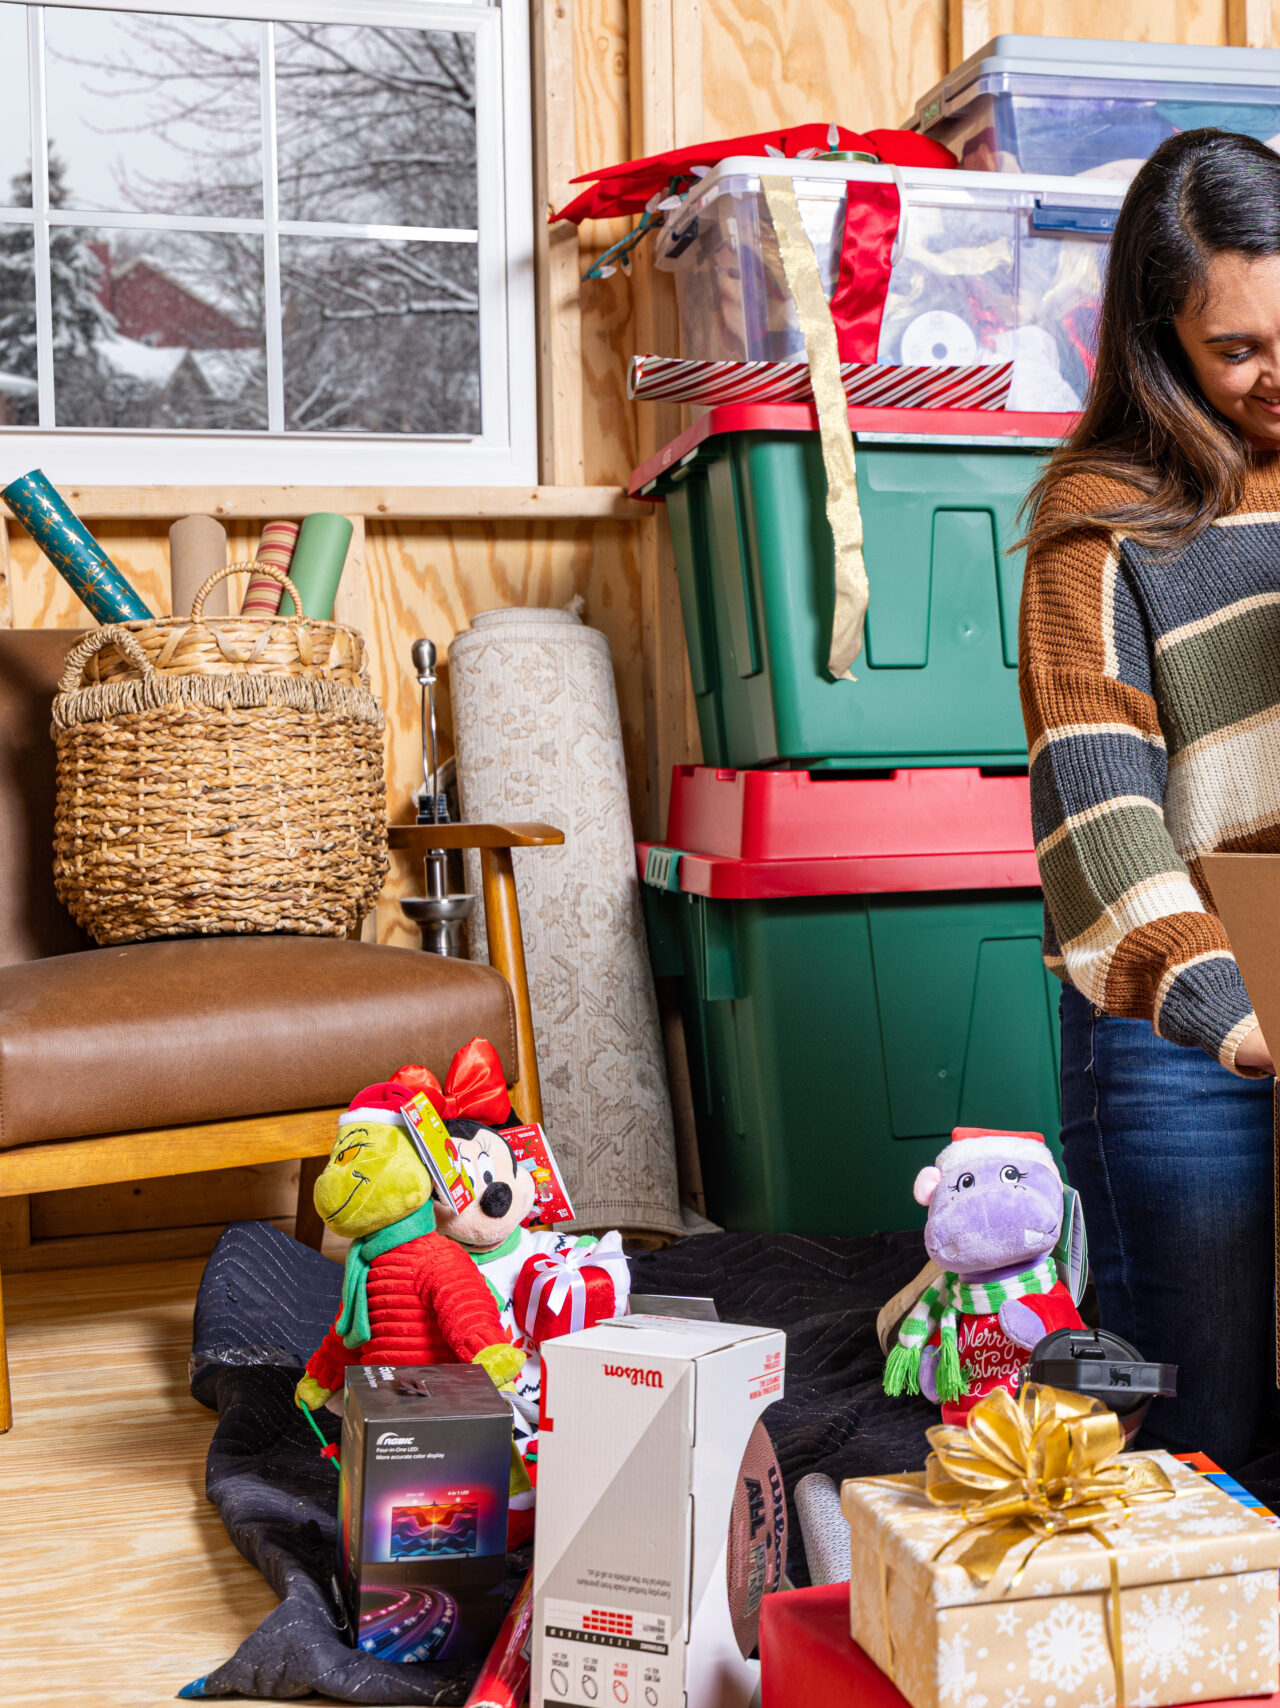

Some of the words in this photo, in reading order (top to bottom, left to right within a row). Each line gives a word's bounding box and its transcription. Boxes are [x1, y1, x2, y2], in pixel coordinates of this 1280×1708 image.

[959, 1321, 1015, 1360] Merry
[601, 1363, 664, 1388] Wilson
[744, 1478, 766, 1540] ALL
